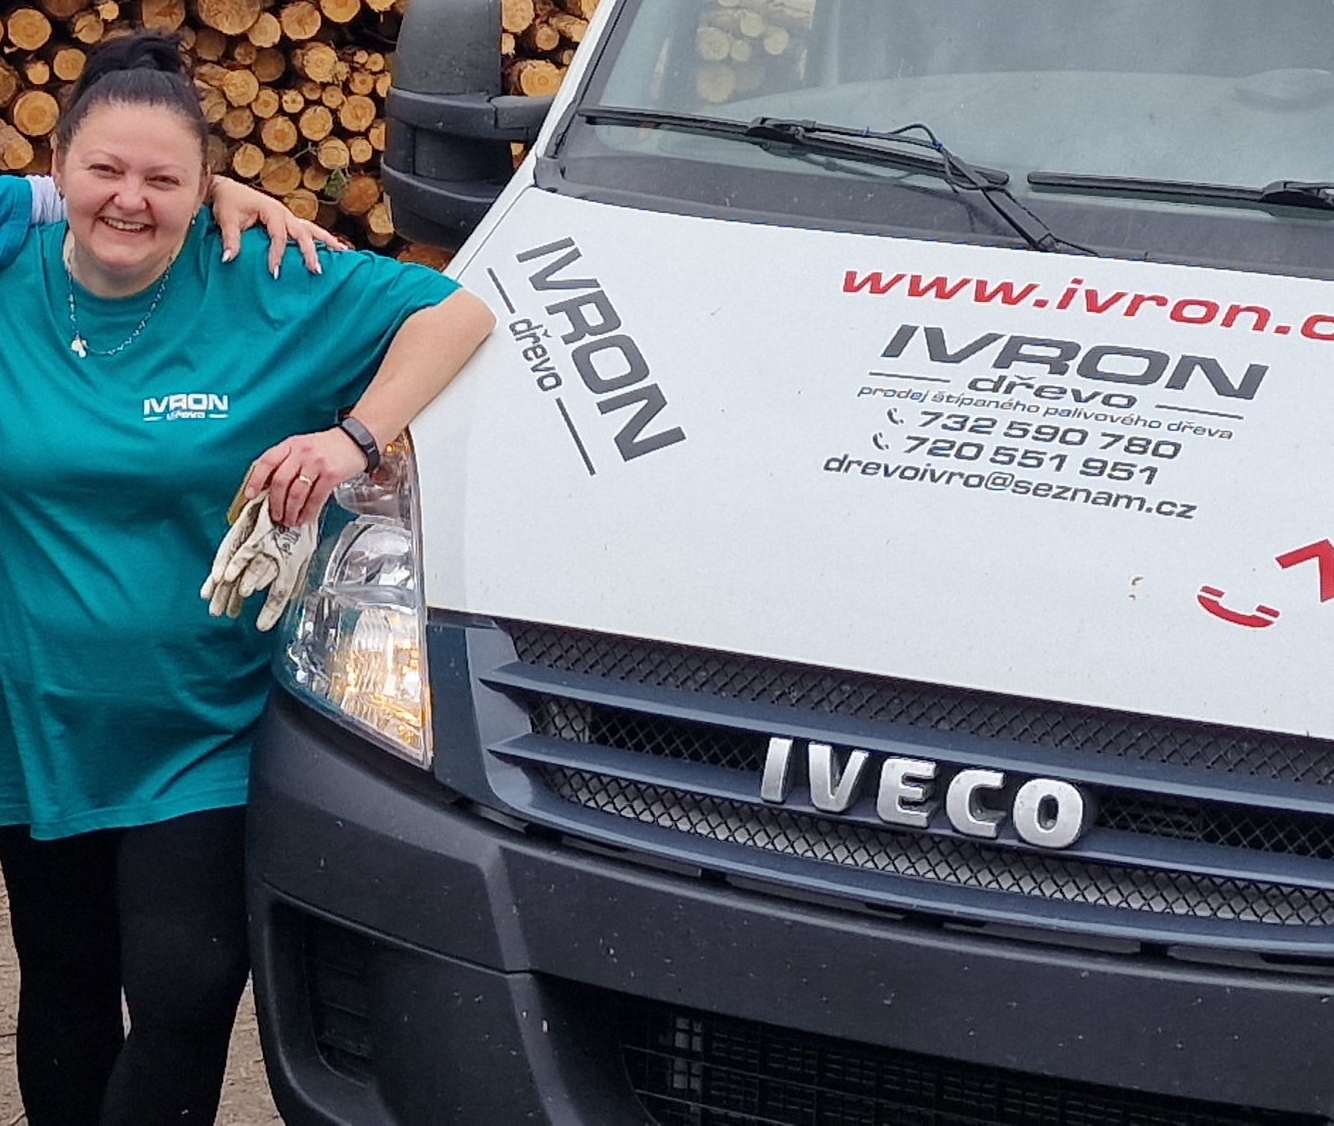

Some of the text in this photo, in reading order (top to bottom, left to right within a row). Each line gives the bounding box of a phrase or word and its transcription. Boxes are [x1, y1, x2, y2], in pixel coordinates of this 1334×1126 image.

[508, 318, 563, 392] dřevo
[516, 237, 686, 462] IVRON
[880, 324, 1270, 400] IVRON
[143, 393, 229, 416] IVRON
[857, 386, 1234, 440] prodej štípaného palivového dřeva
[967, 374, 1138, 409] dřevo
[903, 435, 1159, 485] 720 551 951
[918, 411, 1183, 460] 732 590 780
[823, 453, 1198, 520] drevoivro@seznam.cz
[760, 736, 1085, 849] IVECO
